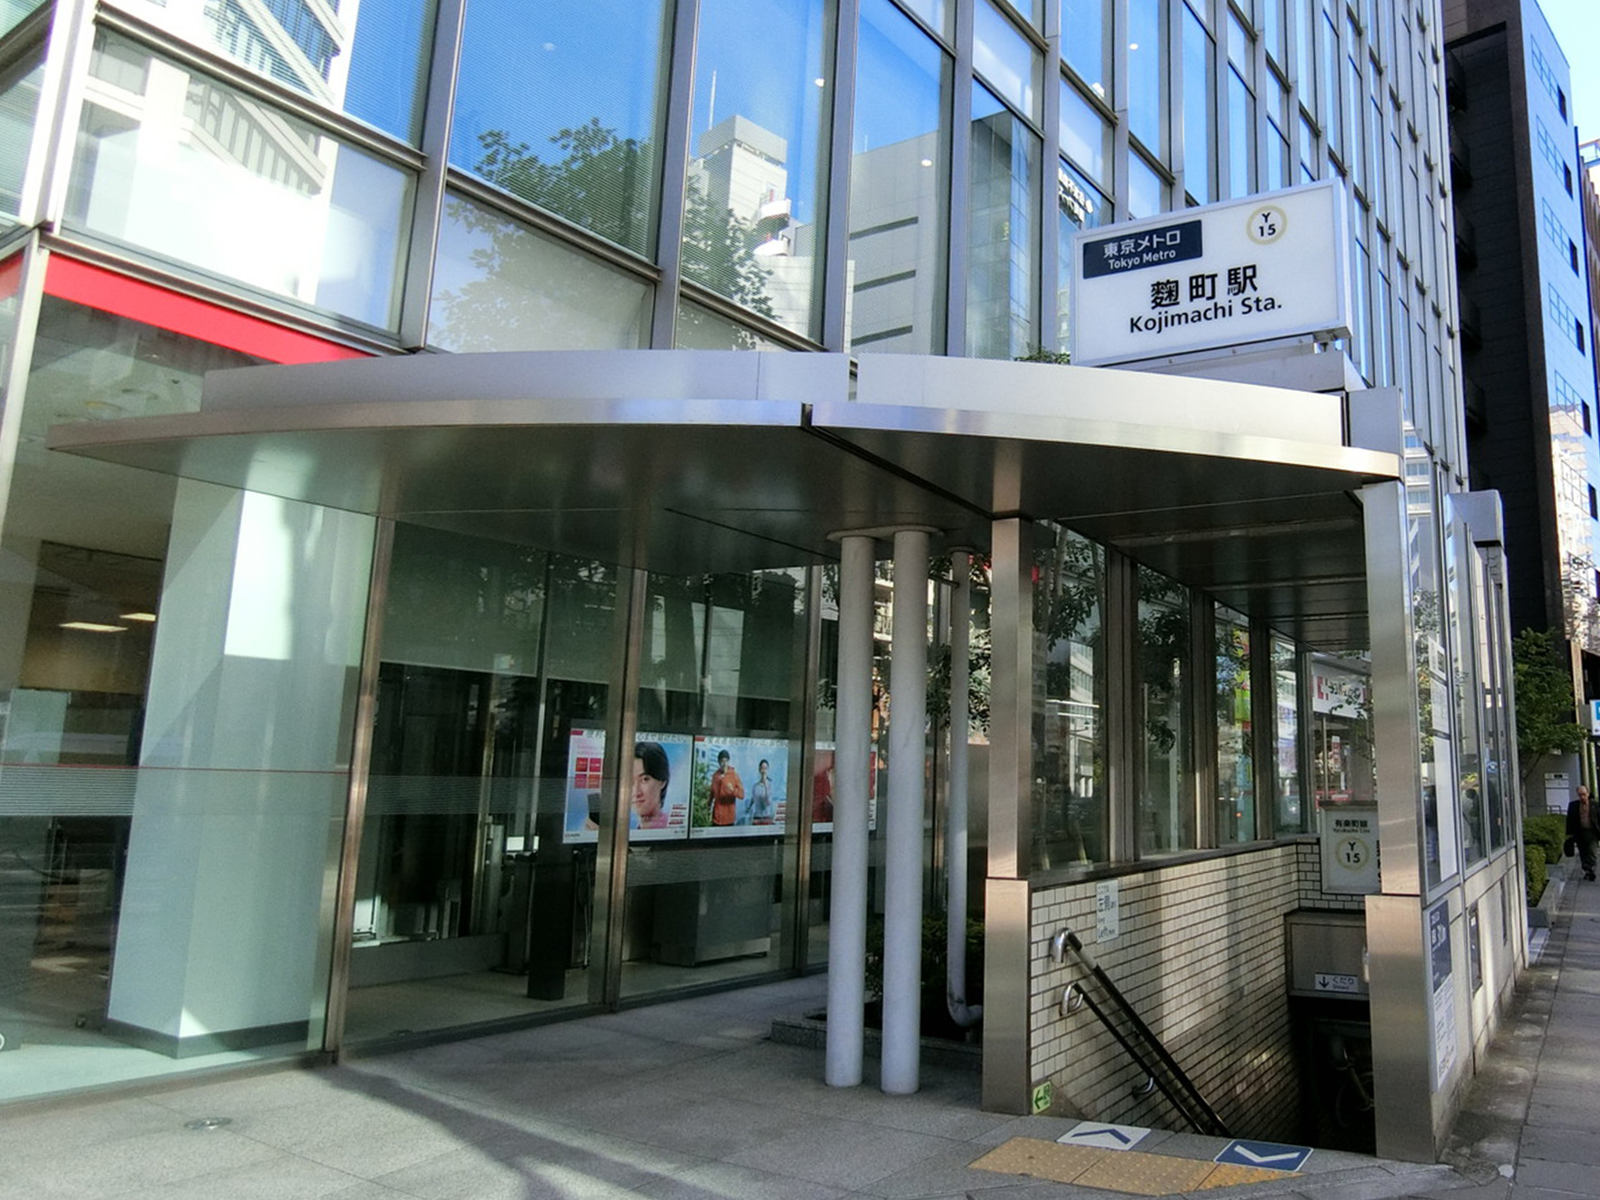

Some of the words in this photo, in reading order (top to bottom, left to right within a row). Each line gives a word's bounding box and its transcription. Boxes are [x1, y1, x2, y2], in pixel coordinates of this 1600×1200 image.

[1261, 211, 1271, 223] Y
[1259, 223, 1276, 237] 15
[1103, 230, 1180, 258] 東京メトロ
[1108, 257, 1140, 270] Tokyo
[1142, 249, 1176, 263] Metro
[1130, 300, 1233, 334] Kojimachi
[1241, 296, 1282, 315] Sta.
[1347, 841, 1357, 851] Y
[1345, 852, 1361, 864] 15
[1332, 976, 1355, 985] くだり
